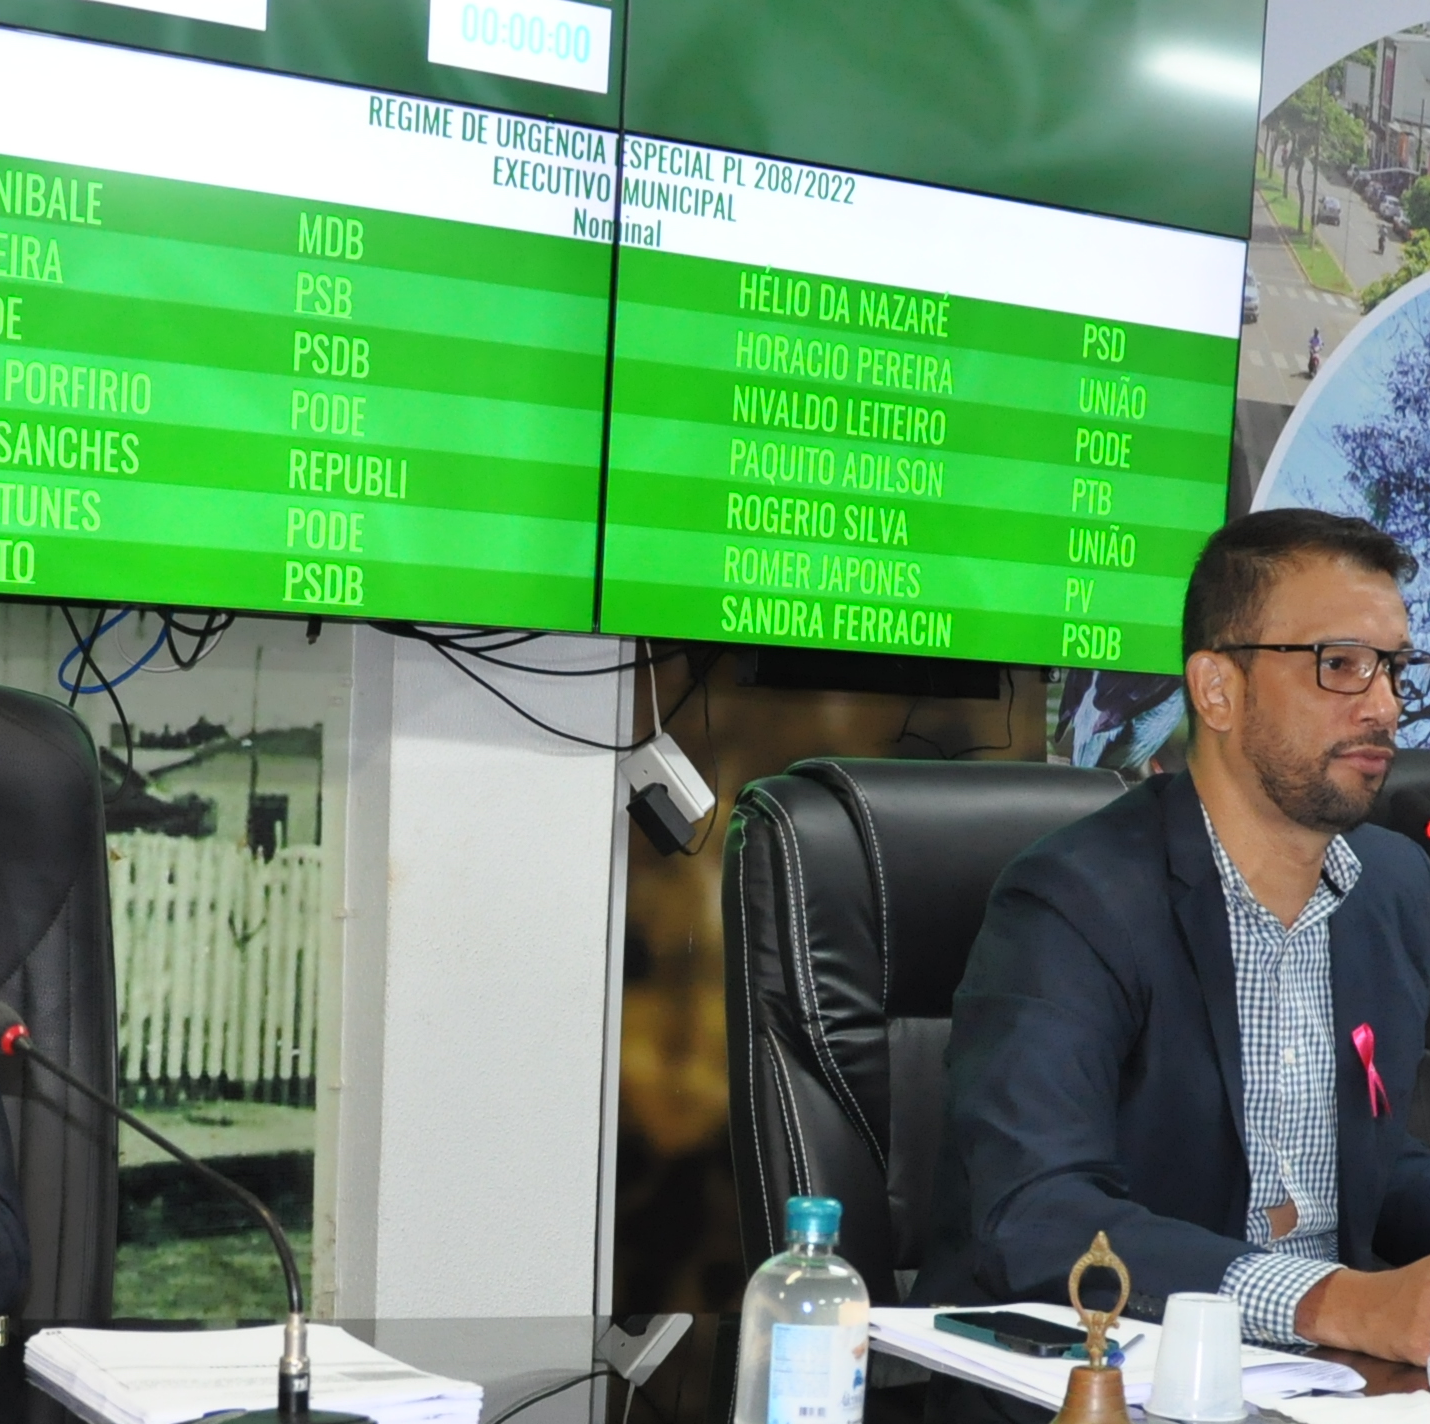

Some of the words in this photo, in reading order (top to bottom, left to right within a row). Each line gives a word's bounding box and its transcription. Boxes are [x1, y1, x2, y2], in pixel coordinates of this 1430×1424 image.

[460, 3, 592, 65] 00:00:00
[369, 96, 454, 139] REGIME
[462, 111, 488, 144] DE
[497, 114, 607, 164] URGÊNCIA
[615, 135, 714, 183] ESPECIAL
[723, 156, 747, 187] PL
[754, 161, 856, 205] 208/2022
[492, 156, 611, 204] EXECUTIVO
[622, 176, 738, 223] MUNICIPAL
[297, 211, 365, 261] MDB
[572, 208, 662, 248] Nominal
[295, 271, 353, 318] PSB
[739, 265, 812, 318] HÉLIO
[818, 284, 851, 323] DA
[858, 291, 951, 338] NAZARÉ
[1083, 323, 1127, 363] PSD
[293, 331, 371, 380] PSDB
[735, 331, 849, 381] HORACIO
[857, 347, 955, 395] PEREIRA
[1079, 375, 1147, 420] UNIÃO
[5, 359, 152, 415] PORFIRIO
[290, 390, 367, 438] PODE
[732, 385, 839, 432] NIVALDO
[845, 400, 947, 446] LEITEIRO
[1075, 428, 1132, 469] PODE
[288, 448, 408, 499] REPUBLI
[730, 438, 835, 487] PAQUITO
[842, 452, 944, 498] ADILSON
[1072, 478, 1113, 516] PTB
[286, 508, 365, 554] PODE
[726, 492, 836, 540] ROGERIO
[844, 508, 910, 547] SILVA
[1068, 524, 1137, 569] UNIÃO
[282, 561, 364, 606] PSDB
[724, 546, 812, 591] ROMER
[817, 556, 921, 599] JAPONES
[1065, 578, 1095, 614] PV
[721, 596, 825, 639] SANDRA
[833, 604, 952, 648] FERRACIN
[1061, 624, 1122, 661] PSDB
